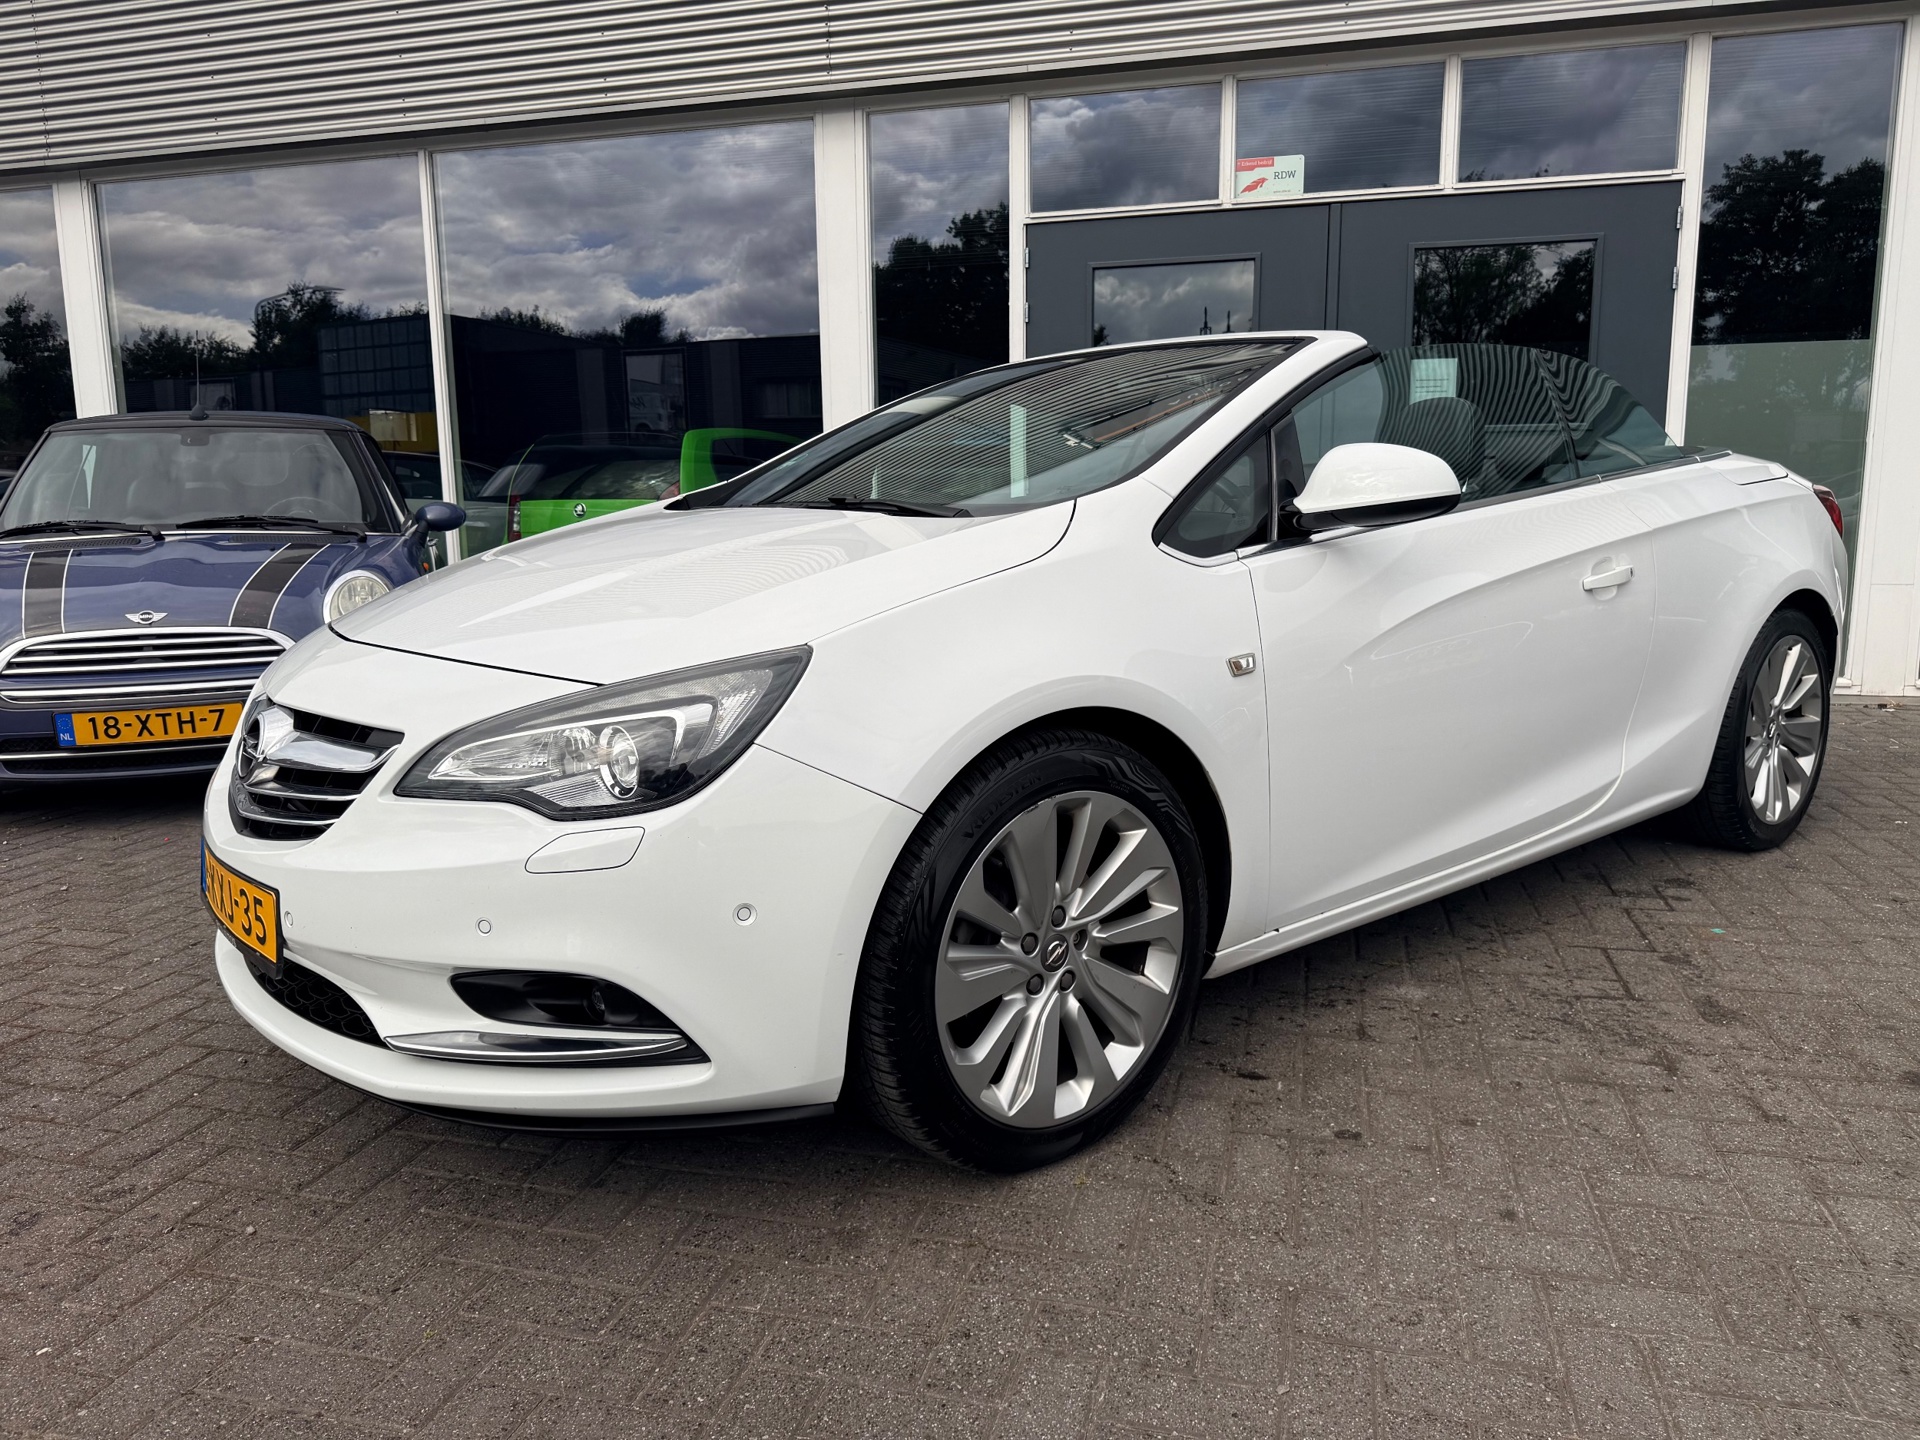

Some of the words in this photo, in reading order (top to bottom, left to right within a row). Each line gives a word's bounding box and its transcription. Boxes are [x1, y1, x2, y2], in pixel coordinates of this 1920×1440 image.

[1273, 170, 1296, 180] RDW
[88, 708, 225, 740] 18-XTH-7
[60, 732, 74, 742] NL
